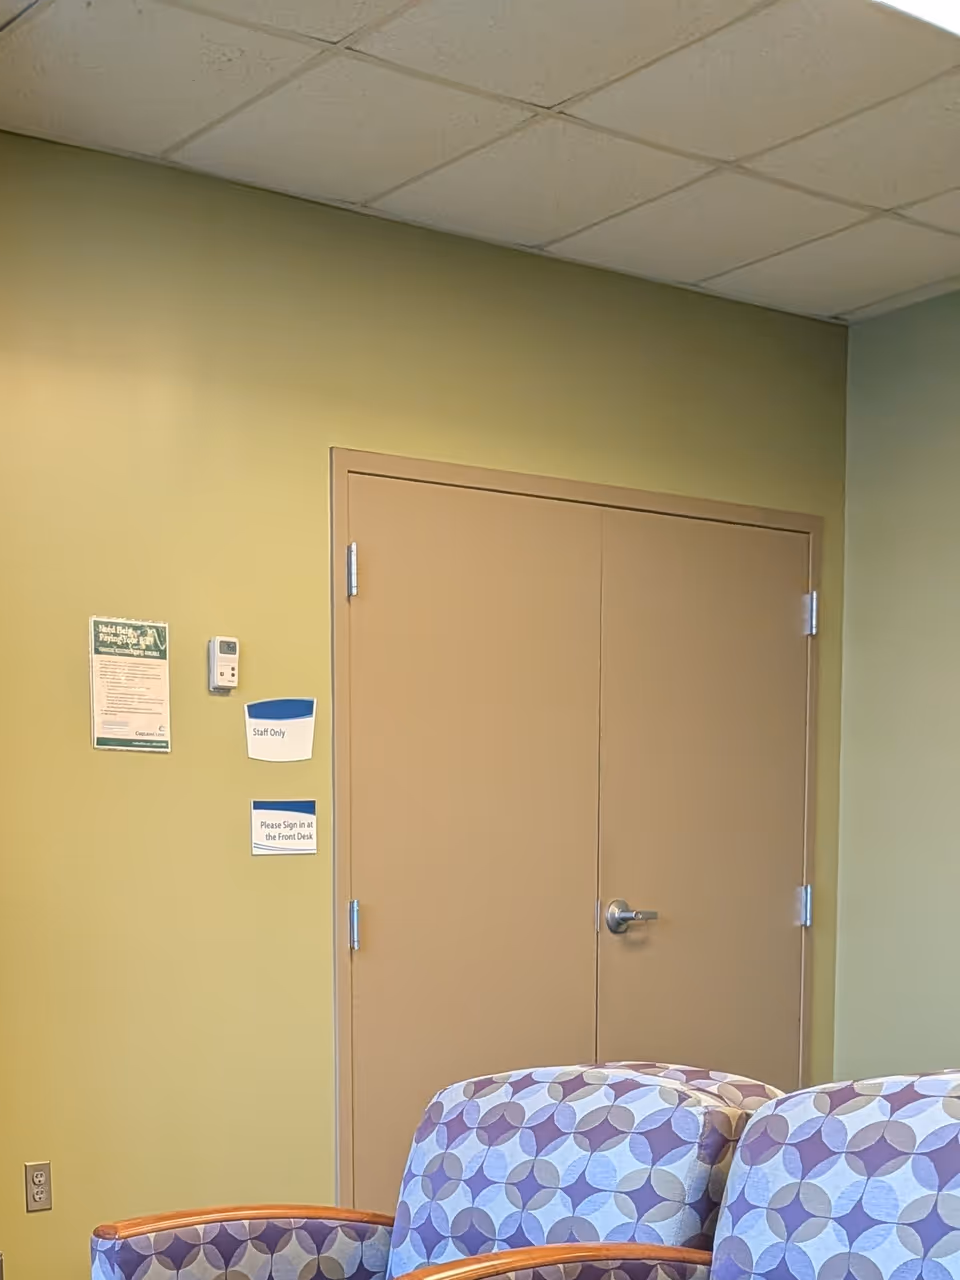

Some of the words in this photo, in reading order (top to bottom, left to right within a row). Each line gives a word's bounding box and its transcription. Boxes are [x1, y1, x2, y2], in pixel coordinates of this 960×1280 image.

[252, 727, 269, 737] Staff
[269, 728, 286, 739] Only
[260, 820, 282, 829] Please
[282, 820, 298, 831] Sign
[298, 820, 306, 829] in
[306, 821, 314, 829] at
[265, 832, 277, 841] the
[278, 832, 296, 841] Front
[296, 832, 314, 841] Desk
